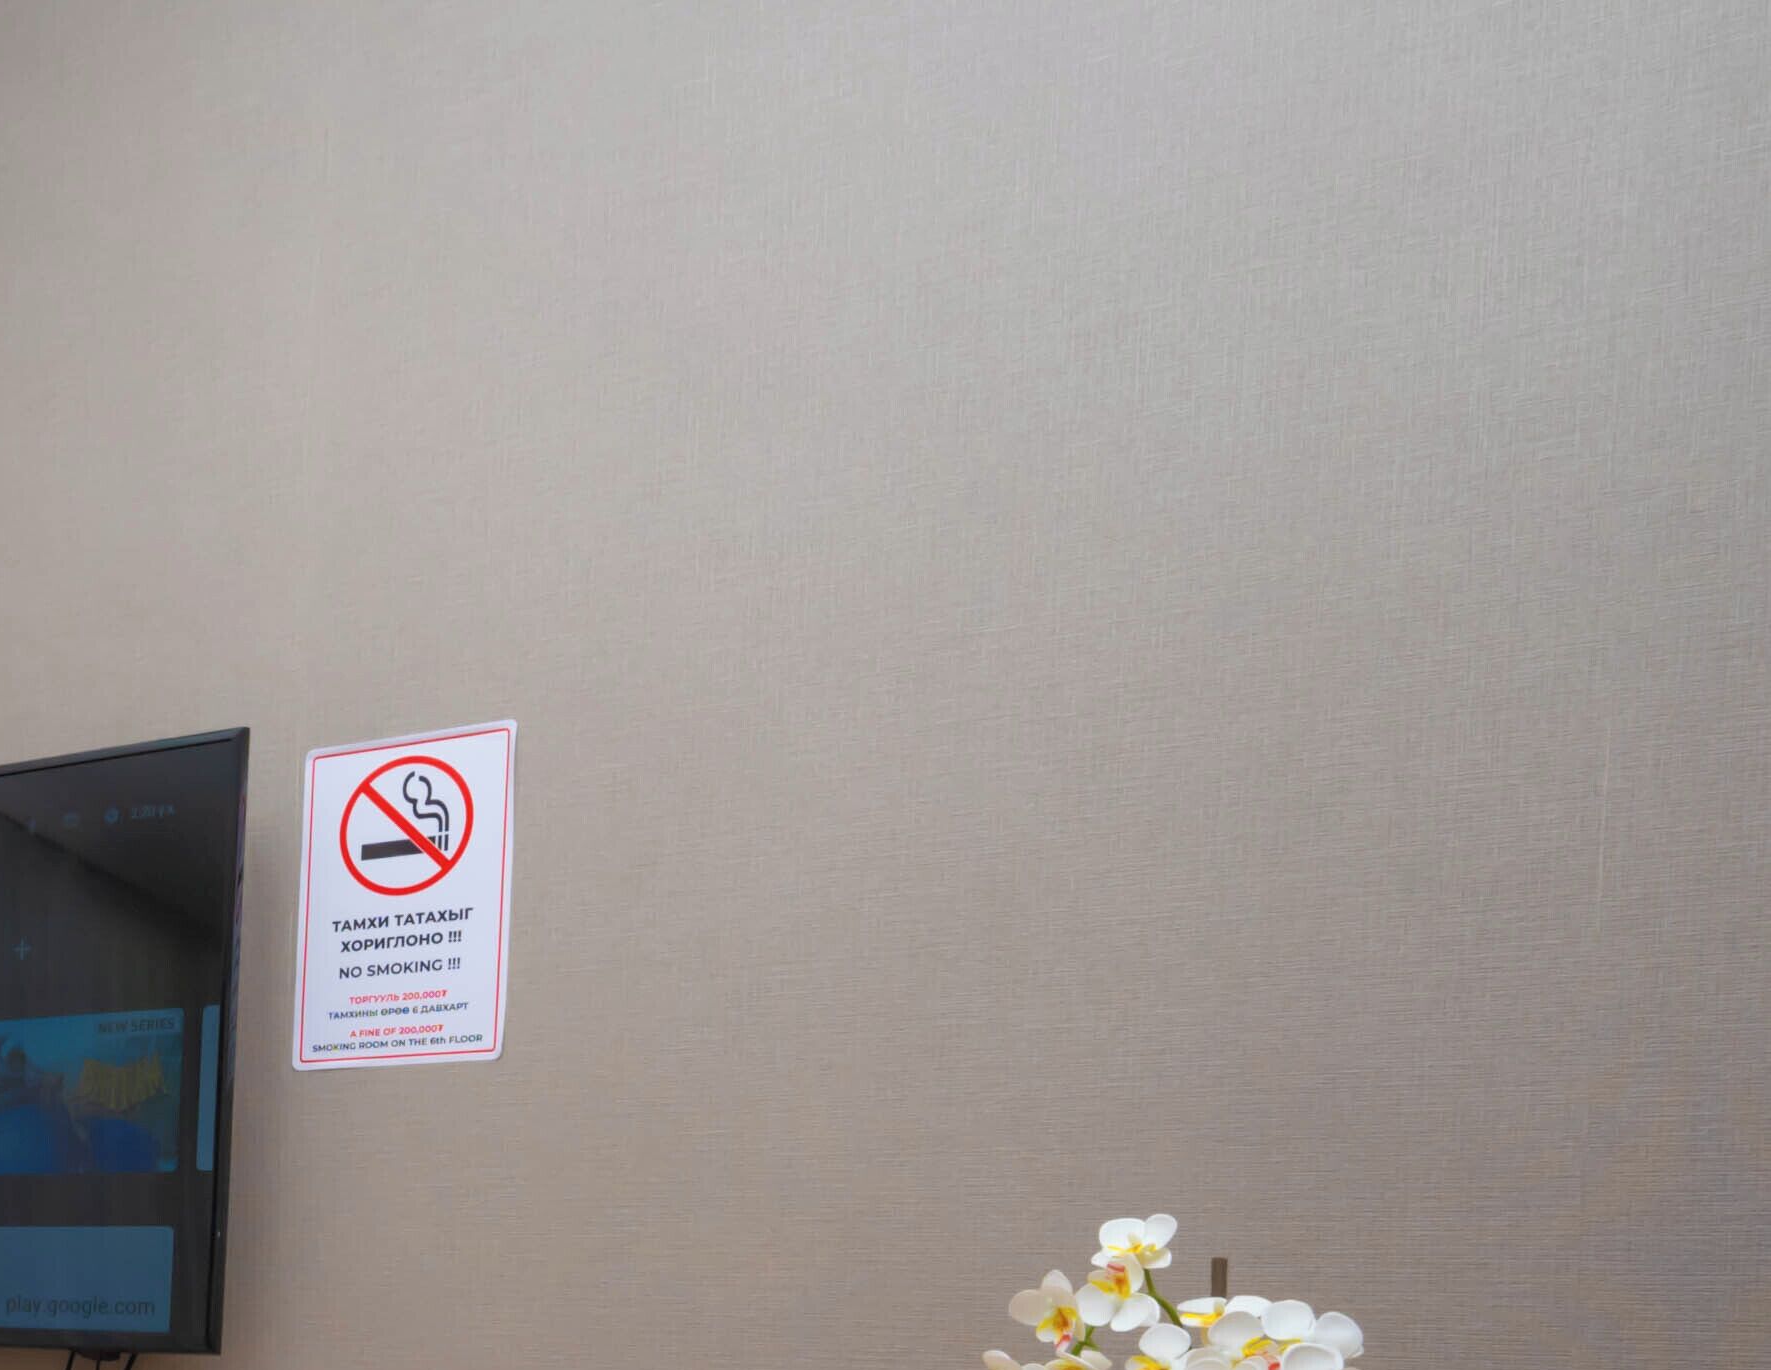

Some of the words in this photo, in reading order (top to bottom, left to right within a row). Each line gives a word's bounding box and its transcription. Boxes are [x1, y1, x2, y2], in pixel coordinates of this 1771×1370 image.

[332, 916, 389, 932] ТАМХИ
[395, 908, 473, 926] ТАТАХЫГ
[341, 932, 443, 952] ХОРИГЛОНО
[448, 930, 462, 943] !!!
[339, 966, 362, 979] NO
[367, 959, 443, 976] SMOKING
[447, 957, 461, 970] !!!
[349, 993, 400, 1005] ТОРГУУЛЬ
[328, 1009, 378, 1020] ТАМХИНЫ
[359, 1028, 380, 1037] FINE
[383, 1027, 398, 1036] OF
[312, 1042, 356, 1052] SMOKING
[359, 1040, 389, 1049] ROOM
[391, 1039, 406, 1048] ON
[408, 1037, 427, 1046] THE
[430, 1036, 446, 1045] 6th
[449, 1034, 483, 1044] FLOOR
[6, 1293, 156, 1320] play.google.com
